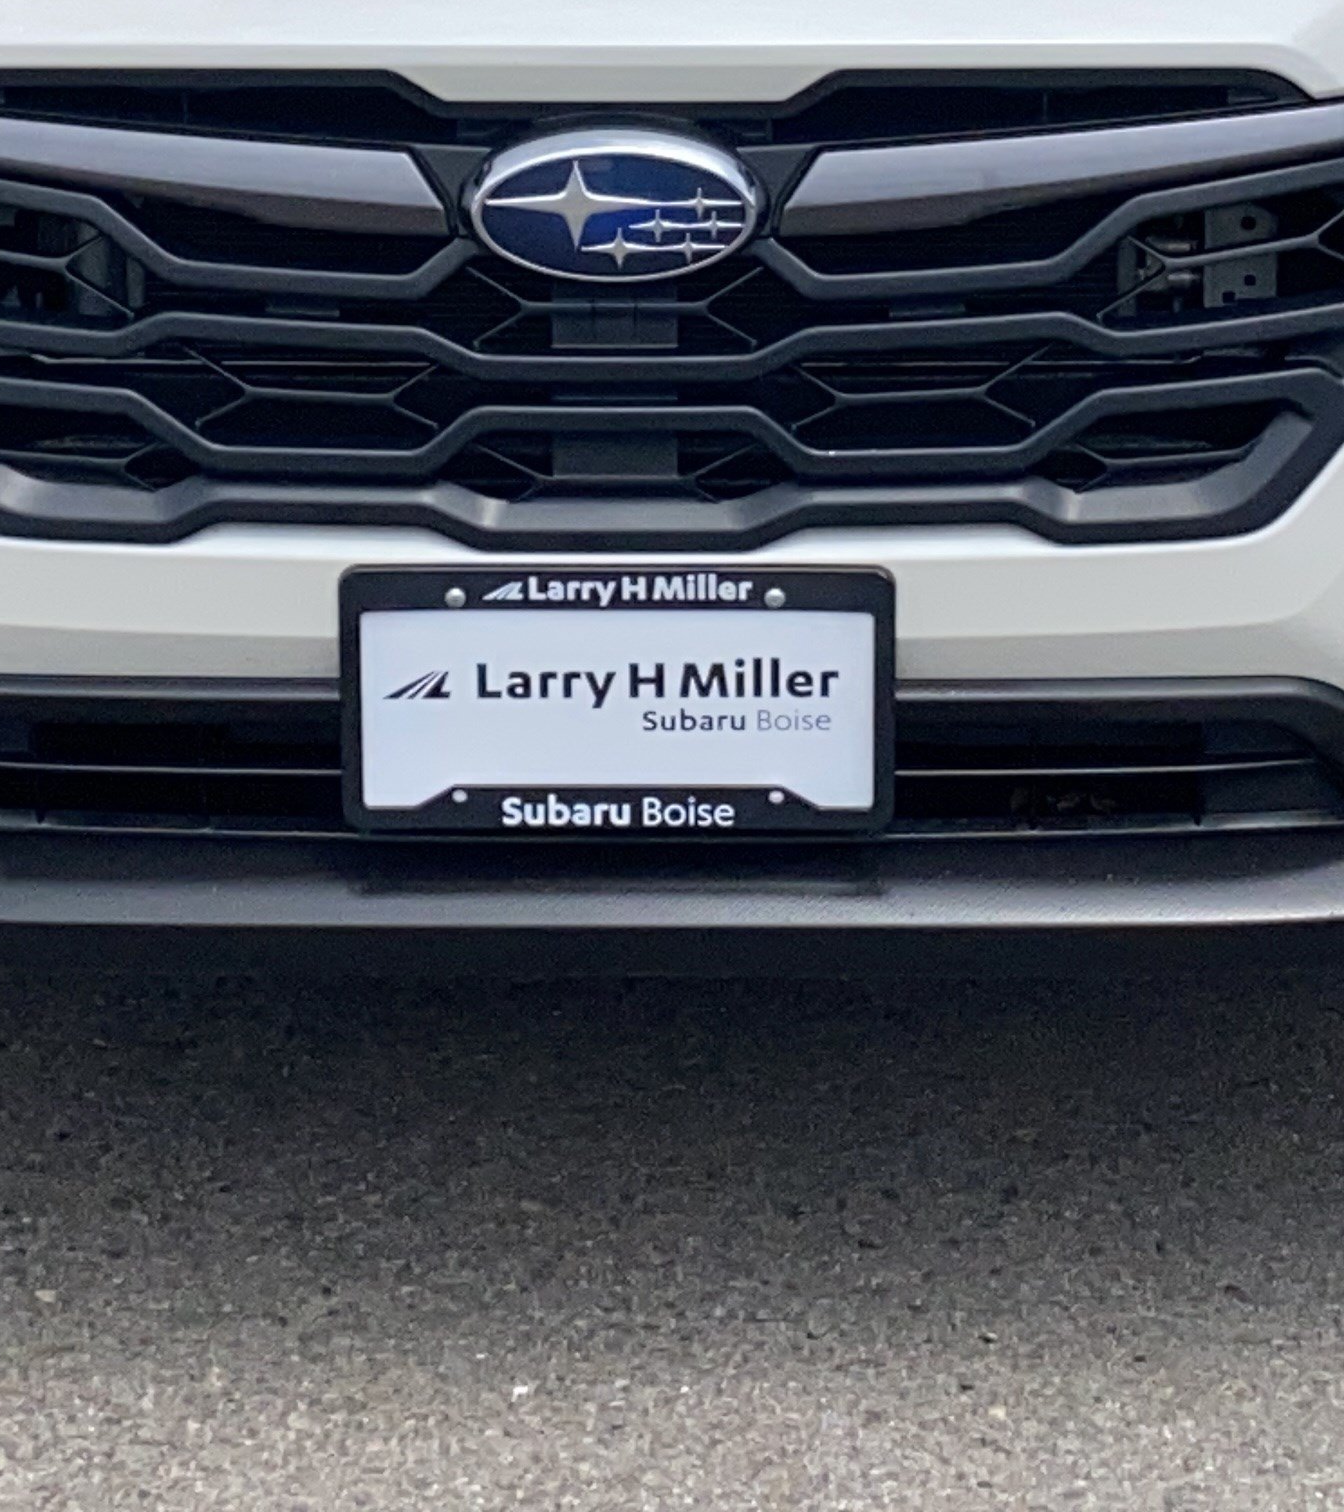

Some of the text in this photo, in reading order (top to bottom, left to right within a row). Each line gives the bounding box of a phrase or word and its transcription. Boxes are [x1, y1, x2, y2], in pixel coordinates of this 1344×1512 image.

[528, 573, 753, 607] Larry H Miller
[476, 657, 839, 709] Larry H Miller
[642, 709, 833, 732] Subaru Boise
[501, 794, 735, 827] Subaru Boise
